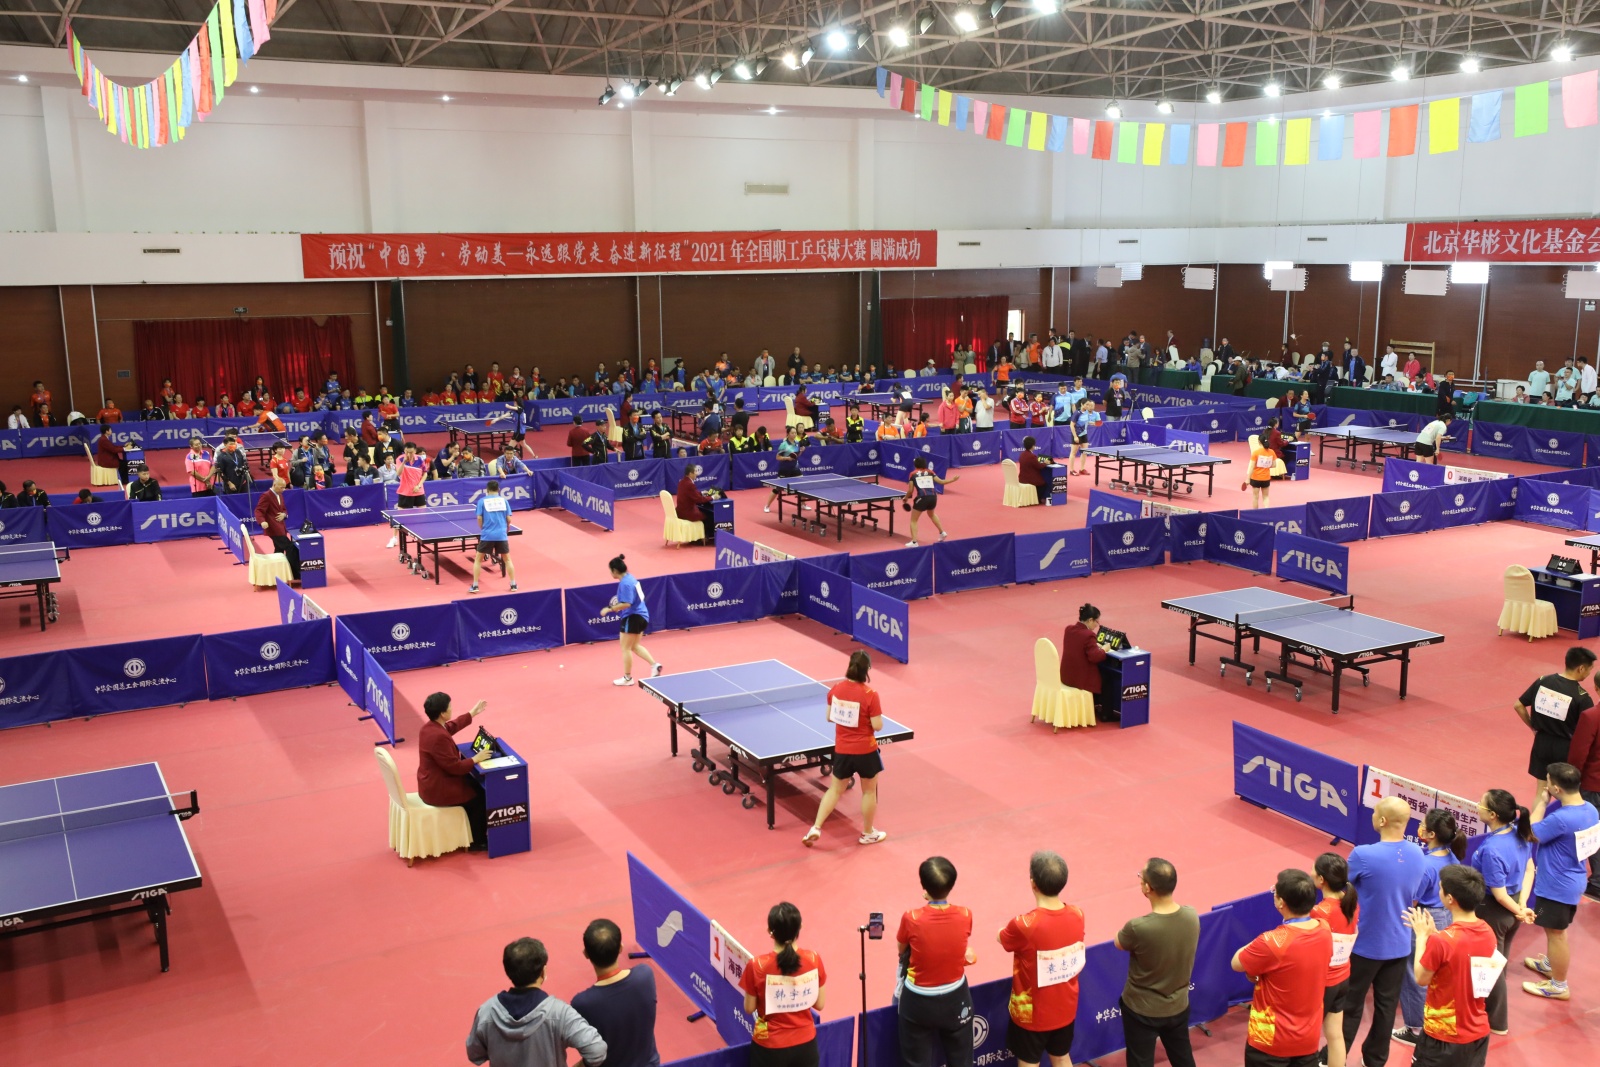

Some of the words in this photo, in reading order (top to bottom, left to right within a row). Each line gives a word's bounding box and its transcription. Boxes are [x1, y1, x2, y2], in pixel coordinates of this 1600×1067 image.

[1423, 227, 1600, 255] 北京华彬文化基金会
[27, 435, 82, 448] STIGA
[91, 431, 144, 445] SIGA
[153, 428, 206, 440] STIGA
[1168, 440, 1205, 456] STIGA
[562, 486, 583, 507] STIGA
[586, 496, 612, 517] STIGA
[1092, 506, 1135, 523] STIGA
[1144, 506, 1149, 517] 1
[141, 511, 216, 530] STIGA
[718, 547, 750, 568] STIGA
[1281, 549, 1342, 580] STIGA
[855, 605, 903, 642] STIGA
[1097, 632, 1105, 642] 8
[1123, 684, 1148, 695] STIGA
[367, 676, 391, 724] STIGA
[474, 735, 482, 748] 6
[875, 738, 893, 746] TIGA
[782, 753, 807, 764] STIGA
[1242, 755, 1348, 817] STIGA
[1371, 778, 1382, 799] 1
[488, 805, 525, 820] STIGA
[1456, 824, 1477, 837] 兵团
[132, 887, 168, 901] STIGA
[0, 916, 24, 928] IGA
[714, 936, 721, 962] 1
[690, 971, 714, 999] STIGA
[1095, 1006, 1123, 1024] 中华全
[974, 1048, 1014, 1067] 国际交流
